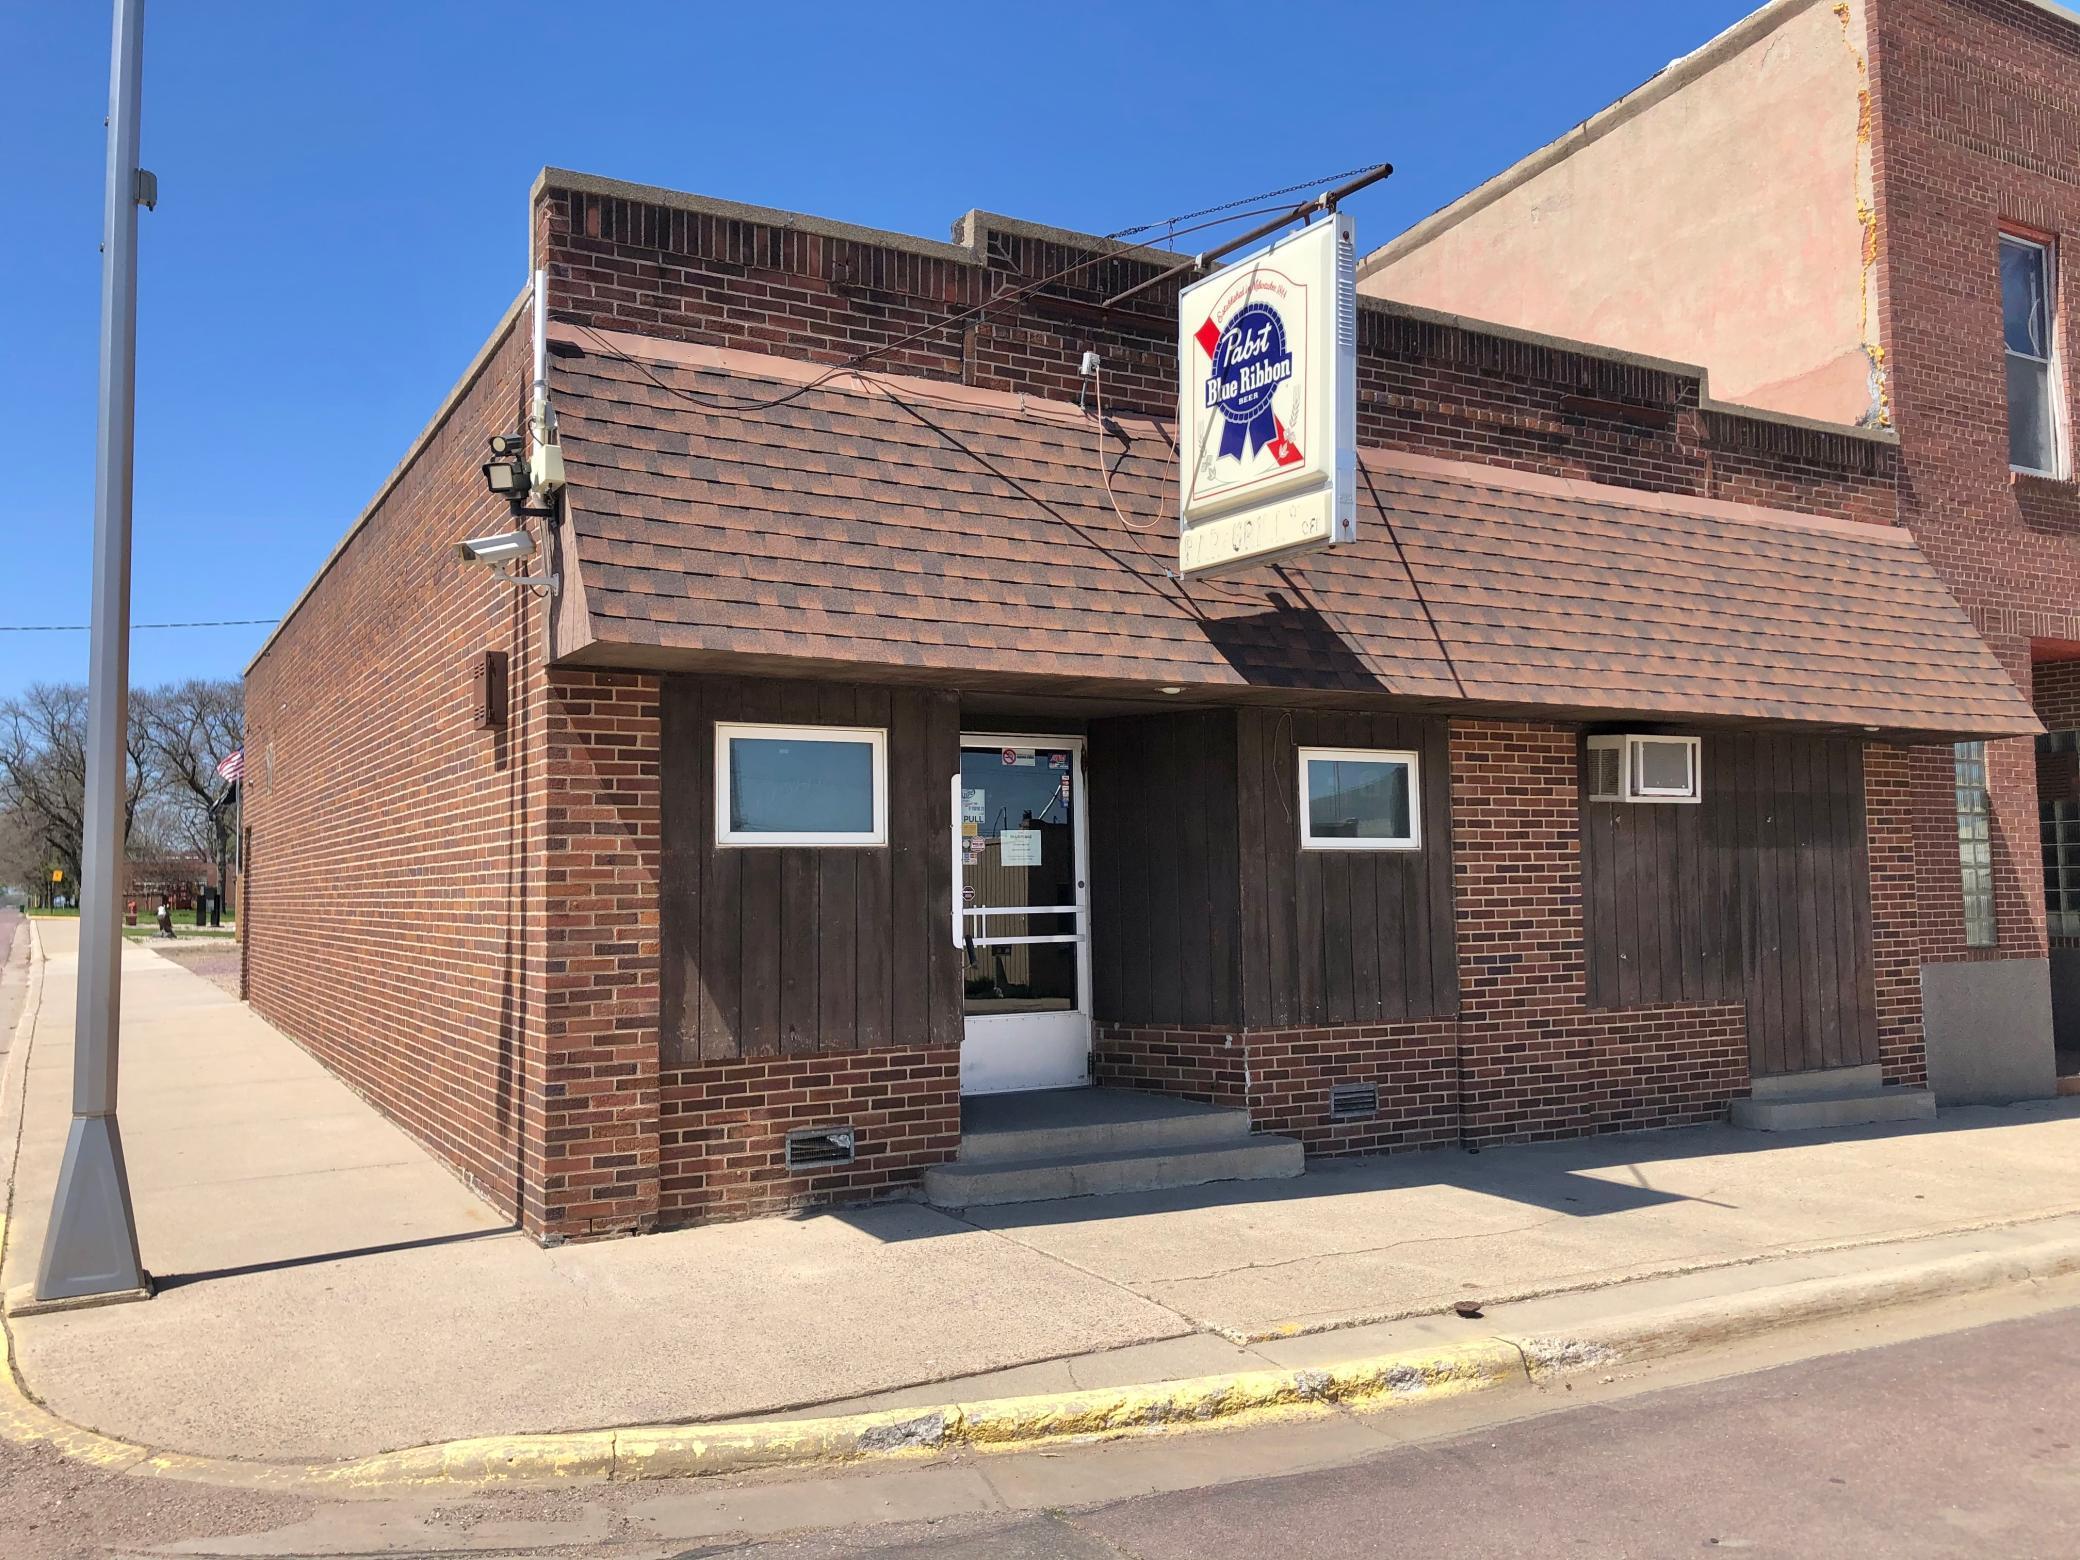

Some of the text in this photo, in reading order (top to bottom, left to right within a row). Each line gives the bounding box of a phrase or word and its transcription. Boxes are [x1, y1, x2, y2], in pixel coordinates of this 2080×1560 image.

[1222, 321, 1272, 367] Pabst
[1207, 358, 1291, 406] Blue Ribbon
[1238, 392, 1259, 405] BEER
[963, 815, 984, 823] PULL
